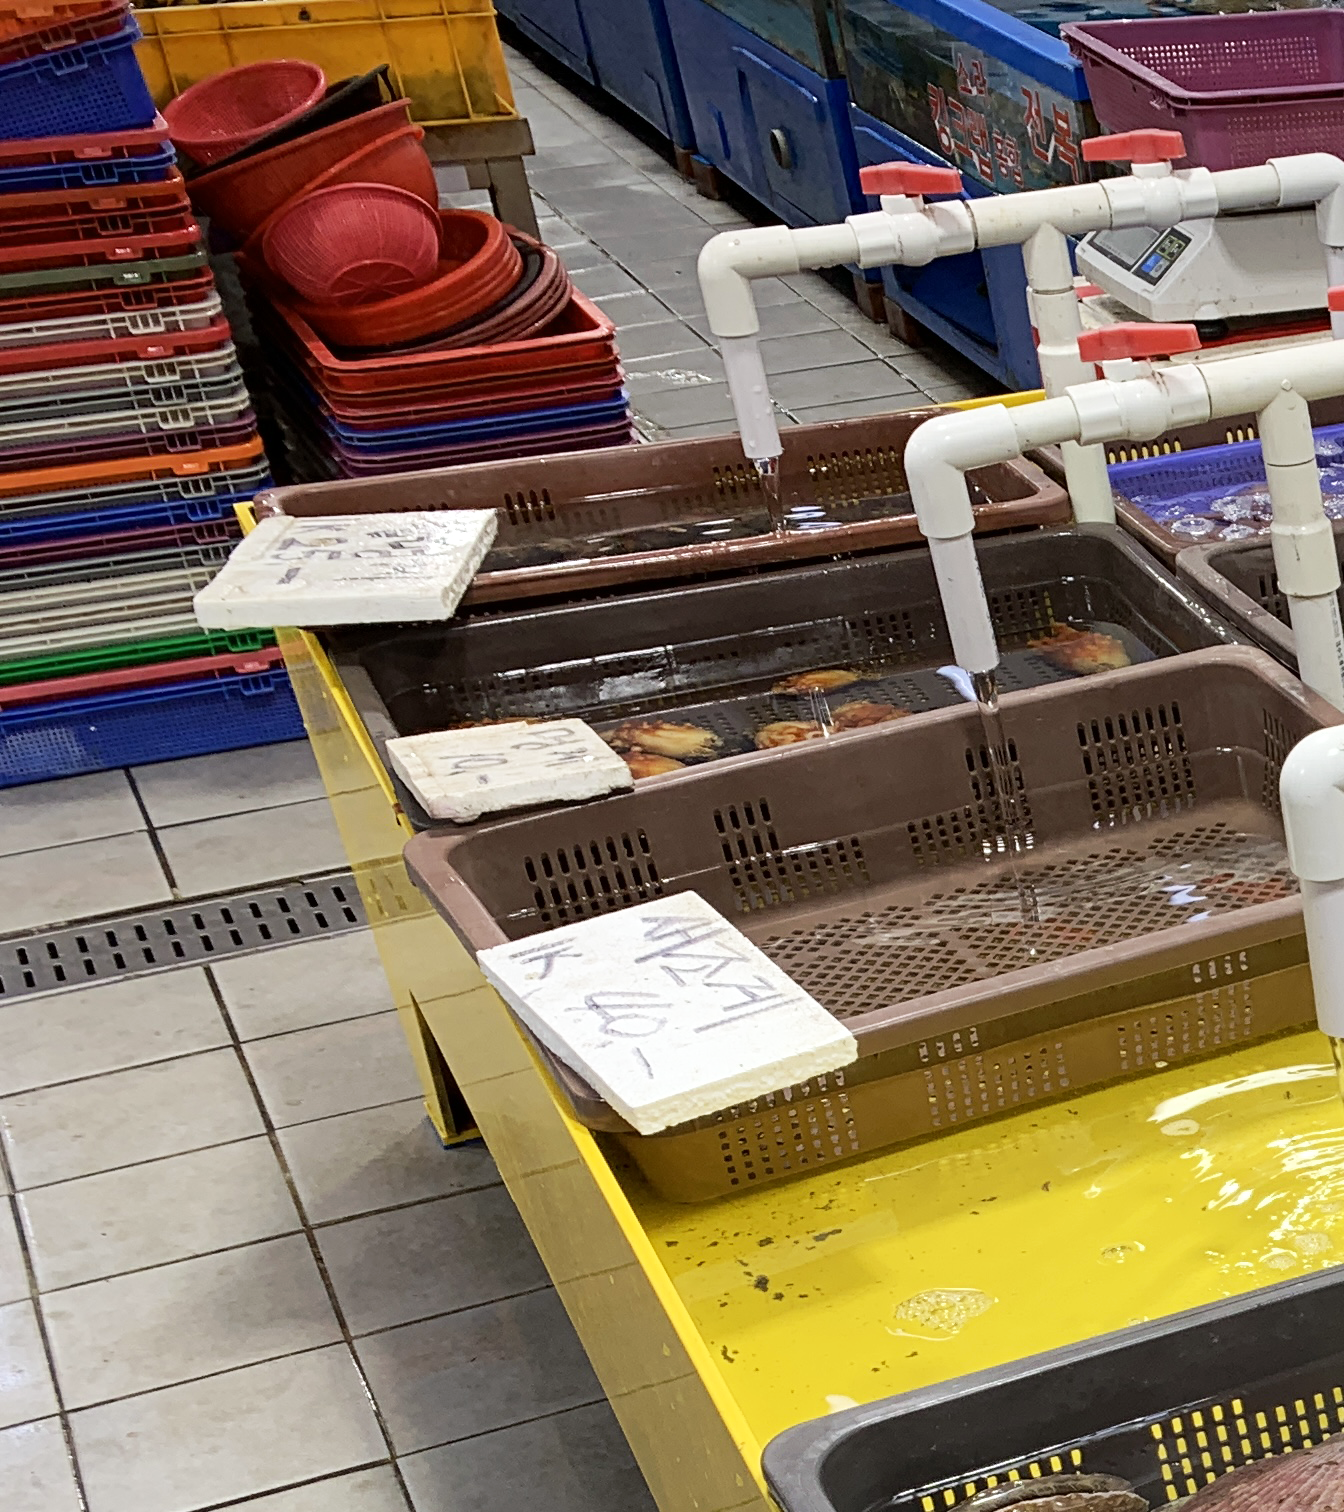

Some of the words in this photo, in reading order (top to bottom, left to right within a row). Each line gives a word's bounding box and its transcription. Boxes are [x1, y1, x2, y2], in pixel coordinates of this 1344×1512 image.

[957, 52, 987, 97] 소라
[927, 82, 996, 185] 킹크랩
[992, 127, 1025, 188] 홍합
[1020, 84, 1080, 184] 전복
